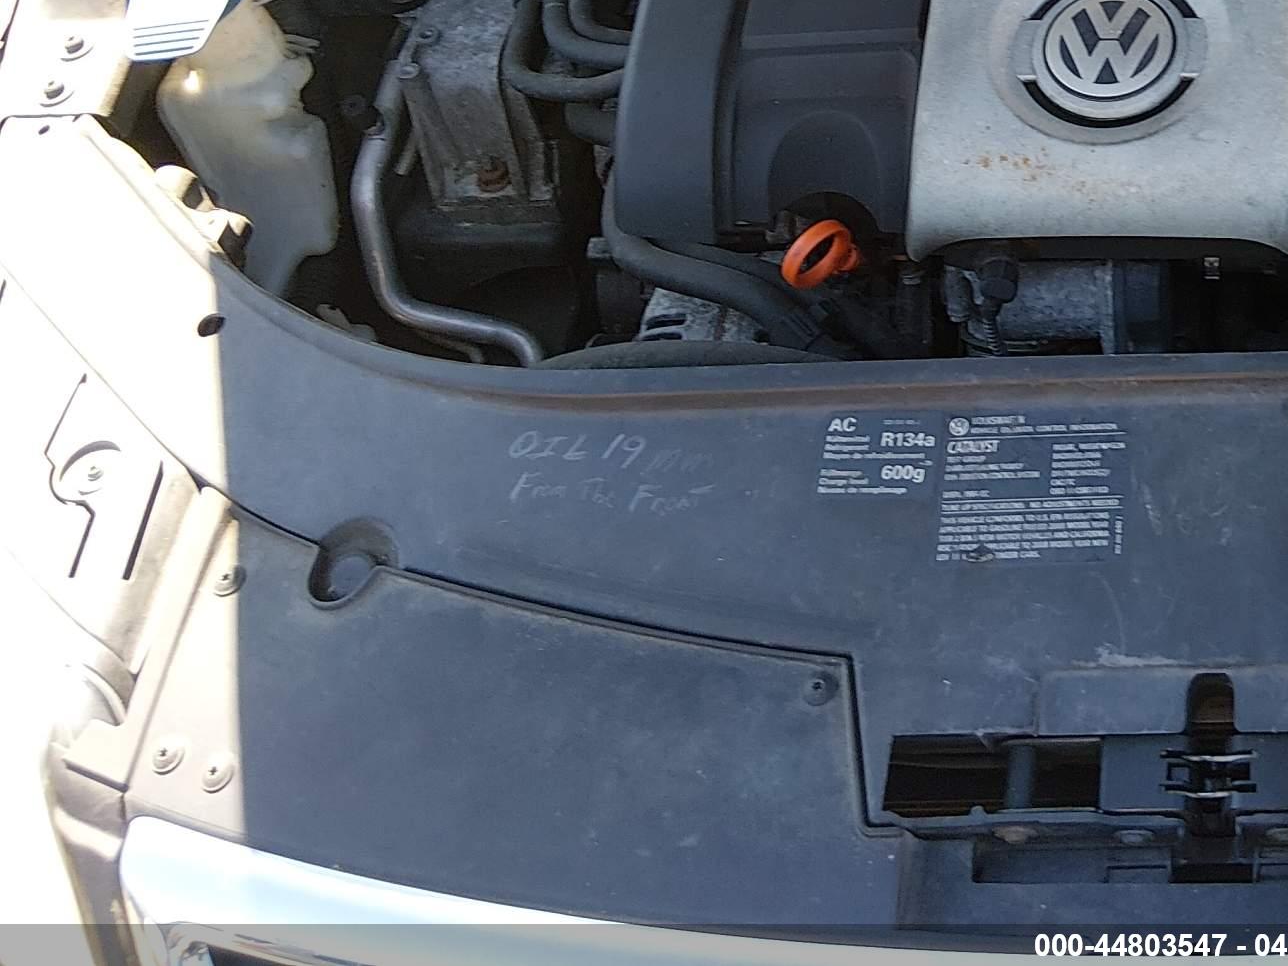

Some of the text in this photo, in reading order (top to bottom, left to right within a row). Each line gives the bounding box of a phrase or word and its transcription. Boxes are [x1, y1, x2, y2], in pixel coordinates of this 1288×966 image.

[827, 417, 857, 432] AC
[880, 432, 936, 447] R134a
[947, 440, 1000, 453] CATALYST
[509, 431, 590, 461] OIL
[601, 433, 647, 469] 19
[881, 465, 925, 483] 600g
